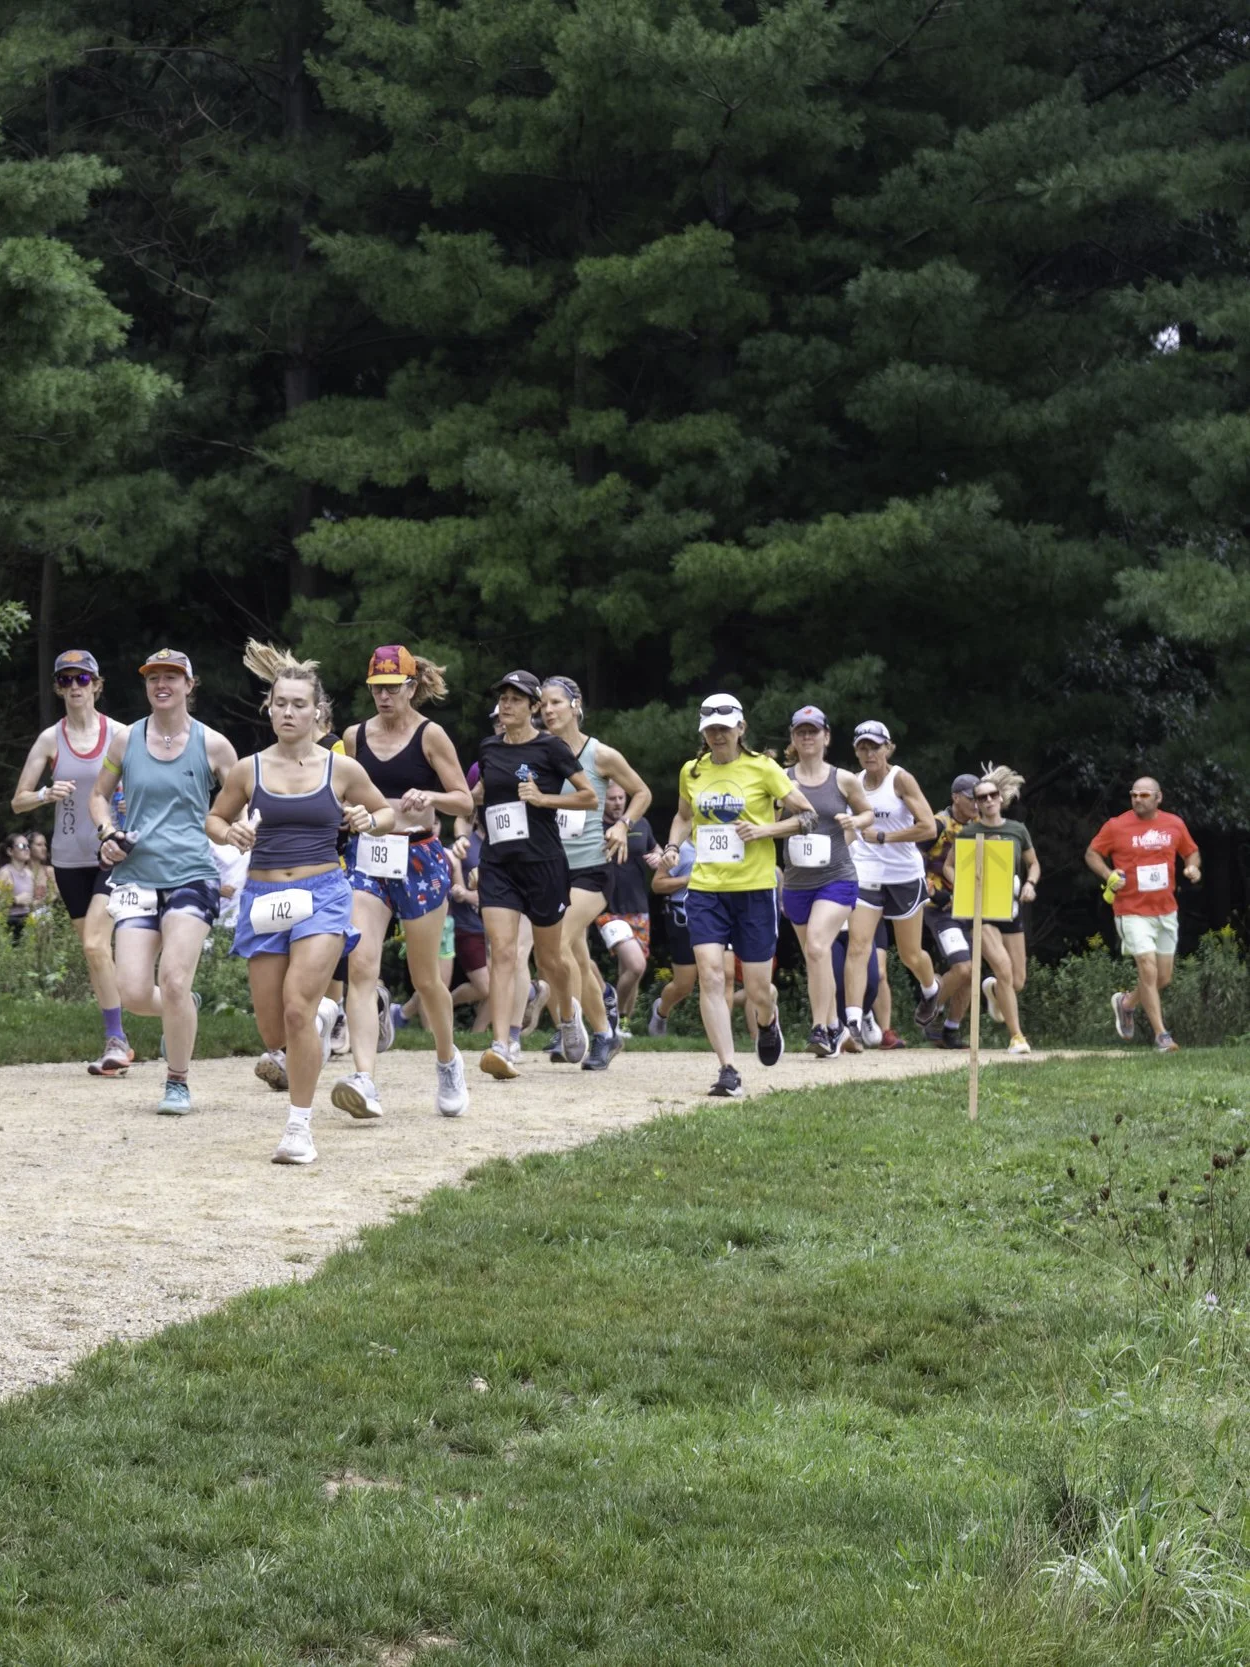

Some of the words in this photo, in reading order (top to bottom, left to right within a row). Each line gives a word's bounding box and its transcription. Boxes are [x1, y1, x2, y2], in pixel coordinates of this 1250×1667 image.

[495, 813, 510, 830] 109
[709, 835, 728, 850] 293
[803, 843, 813, 856] 19
[371, 845, 388, 863] 193
[270, 901, 293, 920] 742
